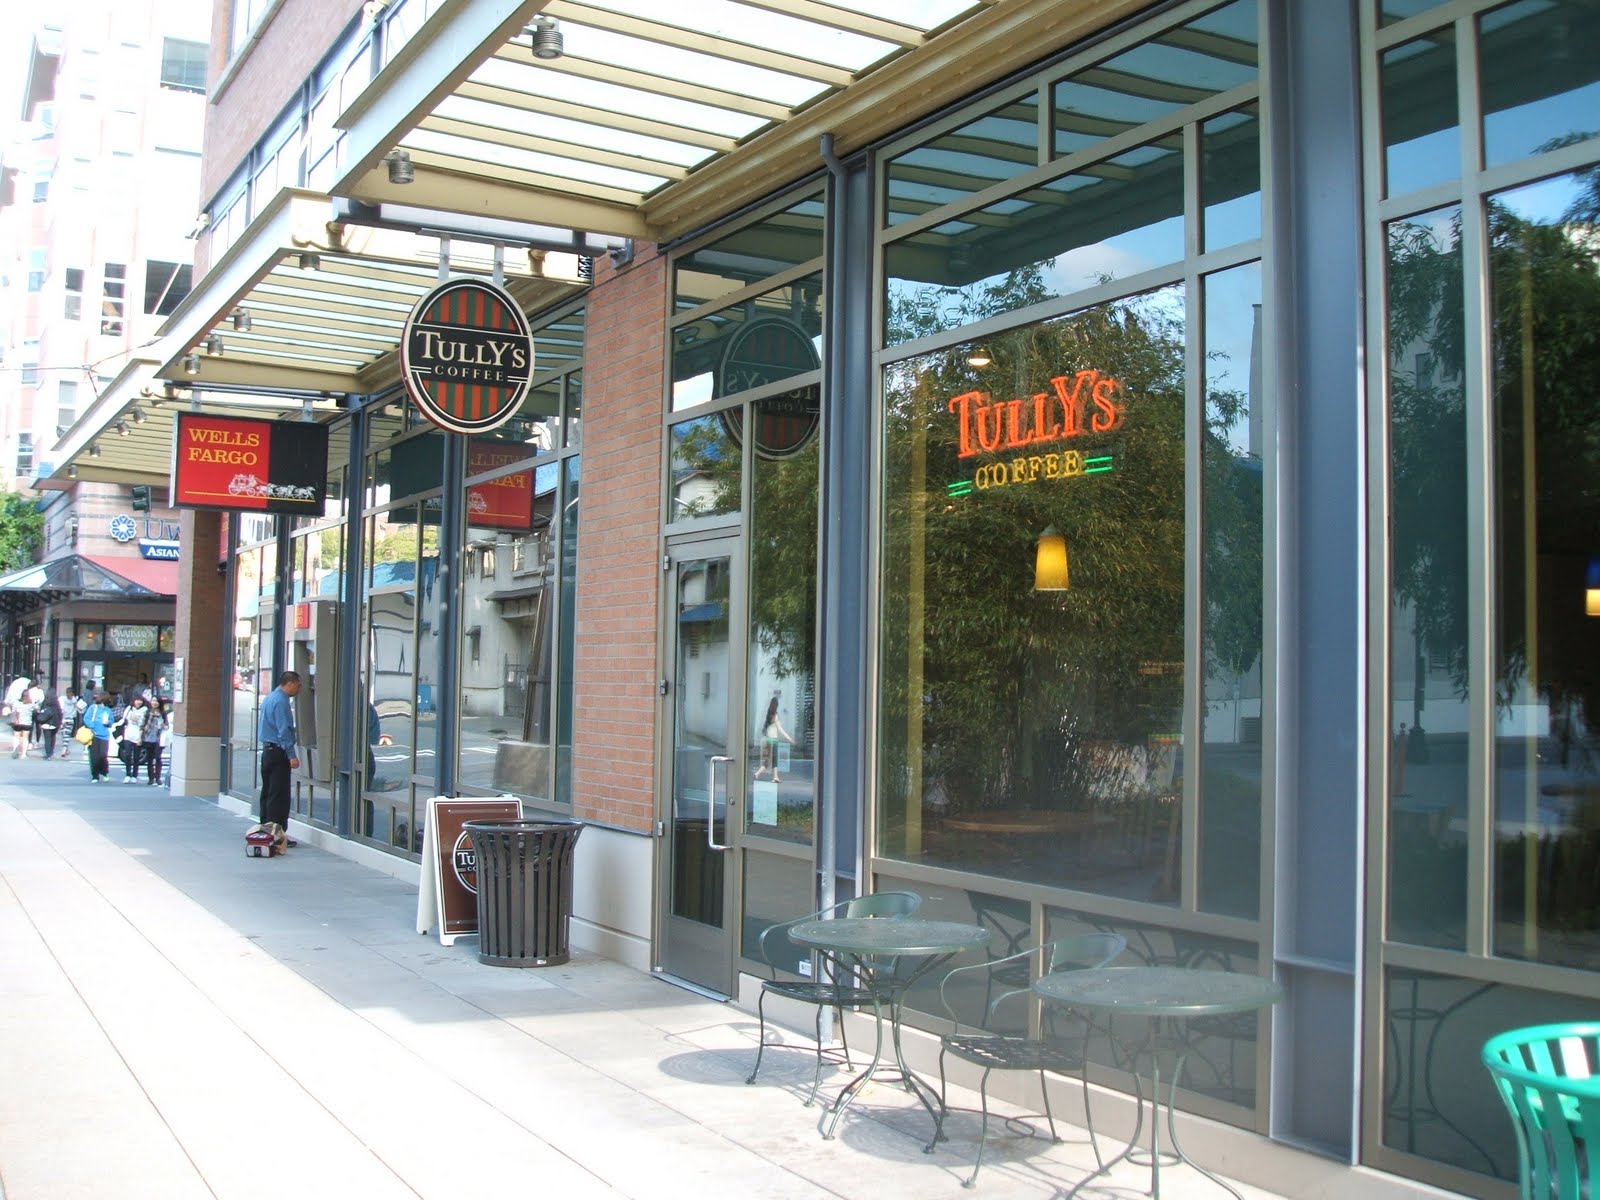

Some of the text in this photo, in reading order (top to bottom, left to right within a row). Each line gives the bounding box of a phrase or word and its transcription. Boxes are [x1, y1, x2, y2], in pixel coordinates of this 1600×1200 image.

[416, 330, 526, 369] TULLY'S
[434, 364, 504, 382] COFFEE
[948, 369, 1117, 459] TULLY'S
[188, 428, 260, 447] WELLS
[188, 447, 258, 466] FARGO
[975, 450, 1081, 490] COFFEE
[115, 637, 147, 647] VILLAGE
